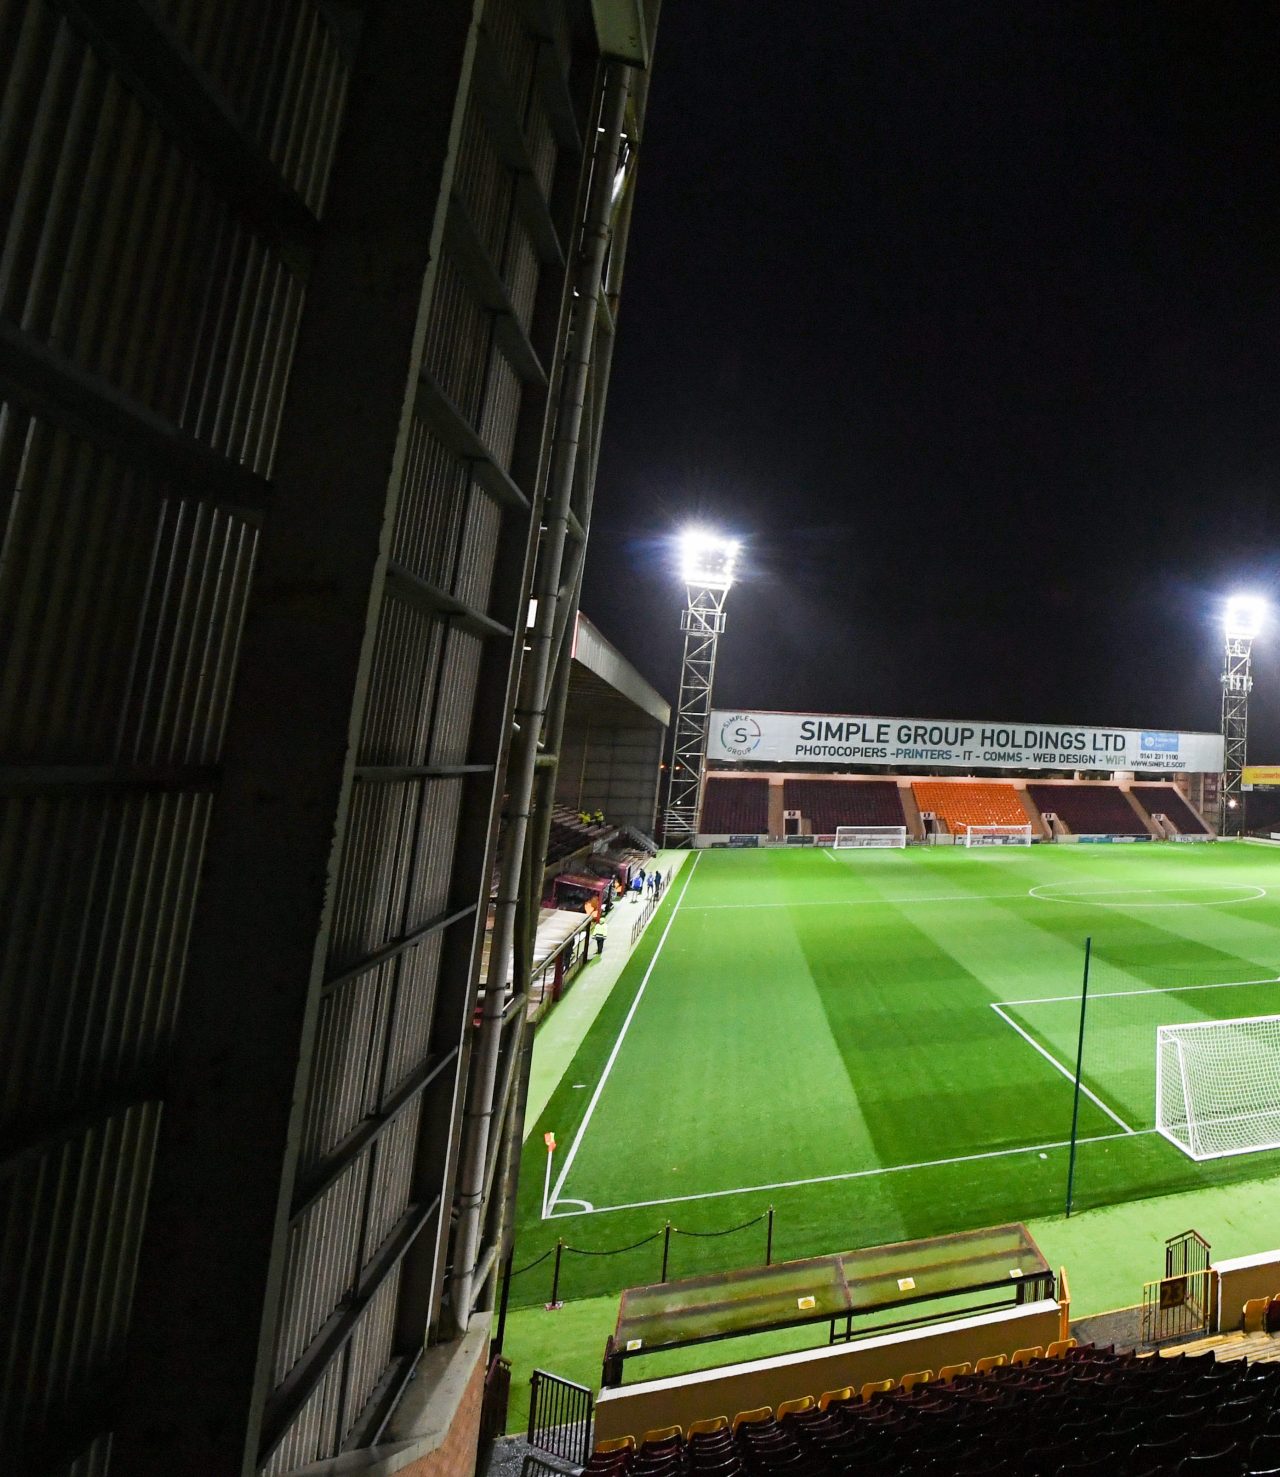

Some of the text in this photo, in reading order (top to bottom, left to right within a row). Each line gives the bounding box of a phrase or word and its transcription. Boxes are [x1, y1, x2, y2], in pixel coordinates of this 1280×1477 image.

[723, 715, 750, 729] SIMPLE
[734, 727, 748, 743] S
[800, 720, 1126, 752] SIMPLE GROUP HOLDINGS LTD
[727, 745, 752, 756] GROUP
[795, 744, 887, 759] PHOTOCOPIERS
[963, 751, 974, 761] IT
[983, 751, 1023, 763] COMMS
[1033, 753, 1056, 763] WEB
[1058, 753, 1096, 765] DESIGN
[1105, 755, 1126, 765] WIFI
